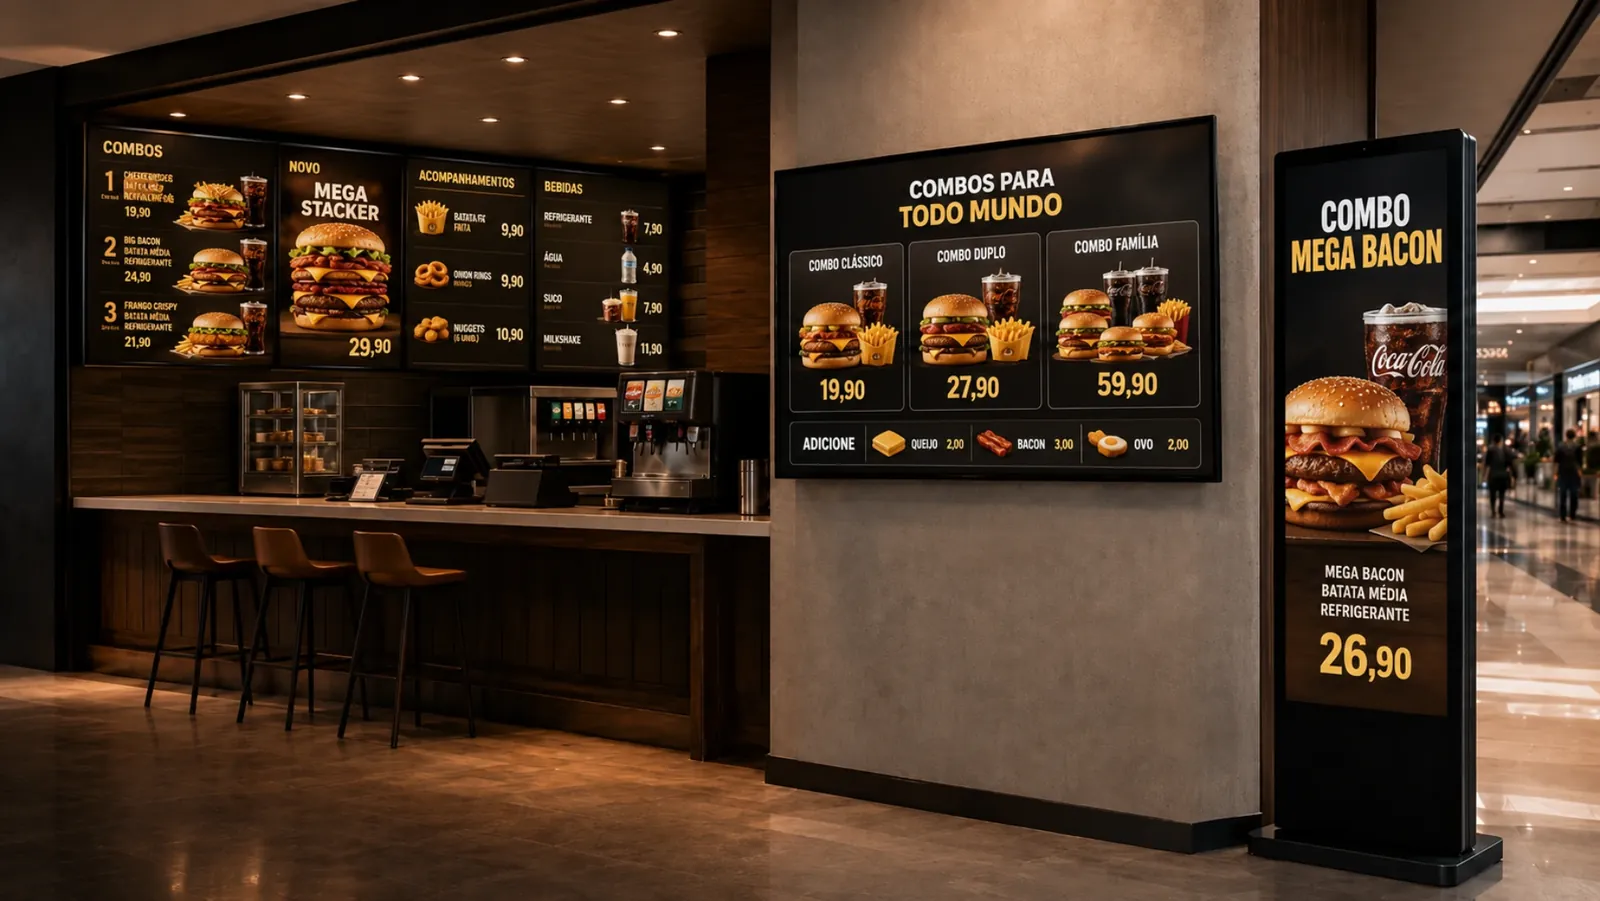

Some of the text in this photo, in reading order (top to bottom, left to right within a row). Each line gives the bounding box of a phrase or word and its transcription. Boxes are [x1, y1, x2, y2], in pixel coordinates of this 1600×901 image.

[103, 140, 163, 158] COMBOS
[289, 160, 320, 174] NOVO
[105, 170, 114, 191] 1
[419, 169, 515, 188] ACOMPANHAMENTOS
[544, 181, 583, 194] BEBIDAS
[909, 168, 1055, 199] COMBOS PARA
[314, 182, 368, 202] MEGA
[124, 206, 151, 218] 19,90
[301, 200, 380, 221] STACKER
[544, 212, 592, 224] REFRIGERANTE
[899, 192, 1063, 228] TODO MUNDO
[1321, 193, 1410, 233] COMBO
[501, 223, 524, 238] 9,90
[643, 222, 663, 236] 7,90
[104, 236, 116, 257] 2
[1074, 232, 1159, 254] COMBO FAMÍLIA
[1291, 228, 1443, 273] MEGA BACON
[544, 251, 564, 262] ÁGUA
[808, 253, 883, 272] COMBO CLÁSSICO
[937, 245, 1006, 263] COMBO DUPLO
[124, 270, 151, 284] 24,90
[643, 262, 663, 275] 4,90
[501, 274, 524, 289] 9,90
[544, 292, 562, 304] SUCO
[104, 301, 117, 323] 3
[643, 302, 663, 315] 7,90
[454, 324, 486, 334] NUGGETS
[496, 328, 524, 342] 10,90
[124, 336, 151, 348] 21,90
[349, 337, 392, 358] 29,90
[544, 334, 582, 344] MILKSHAKE
[640, 342, 663, 356] 11,90
[1371, 343, 1447, 378] Coca-Cola
[820, 378, 866, 403] 19,90
[947, 375, 1000, 401] 27,90
[1098, 371, 1158, 399] 59,90
[802, 437, 856, 450] ADICIONE
[911, 438, 964, 450] QUEIJO 2,00
[1018, 438, 1074, 451] BACON 3,00
[1134, 438, 1189, 451] OVO 2,00
[1324, 564, 1404, 582] MEGA BACON
[1321, 584, 1408, 602] BATATA MÉDIA
[1320, 603, 1410, 622] REFRIGERANTE
[1320, 632, 1412, 682] 26,90
